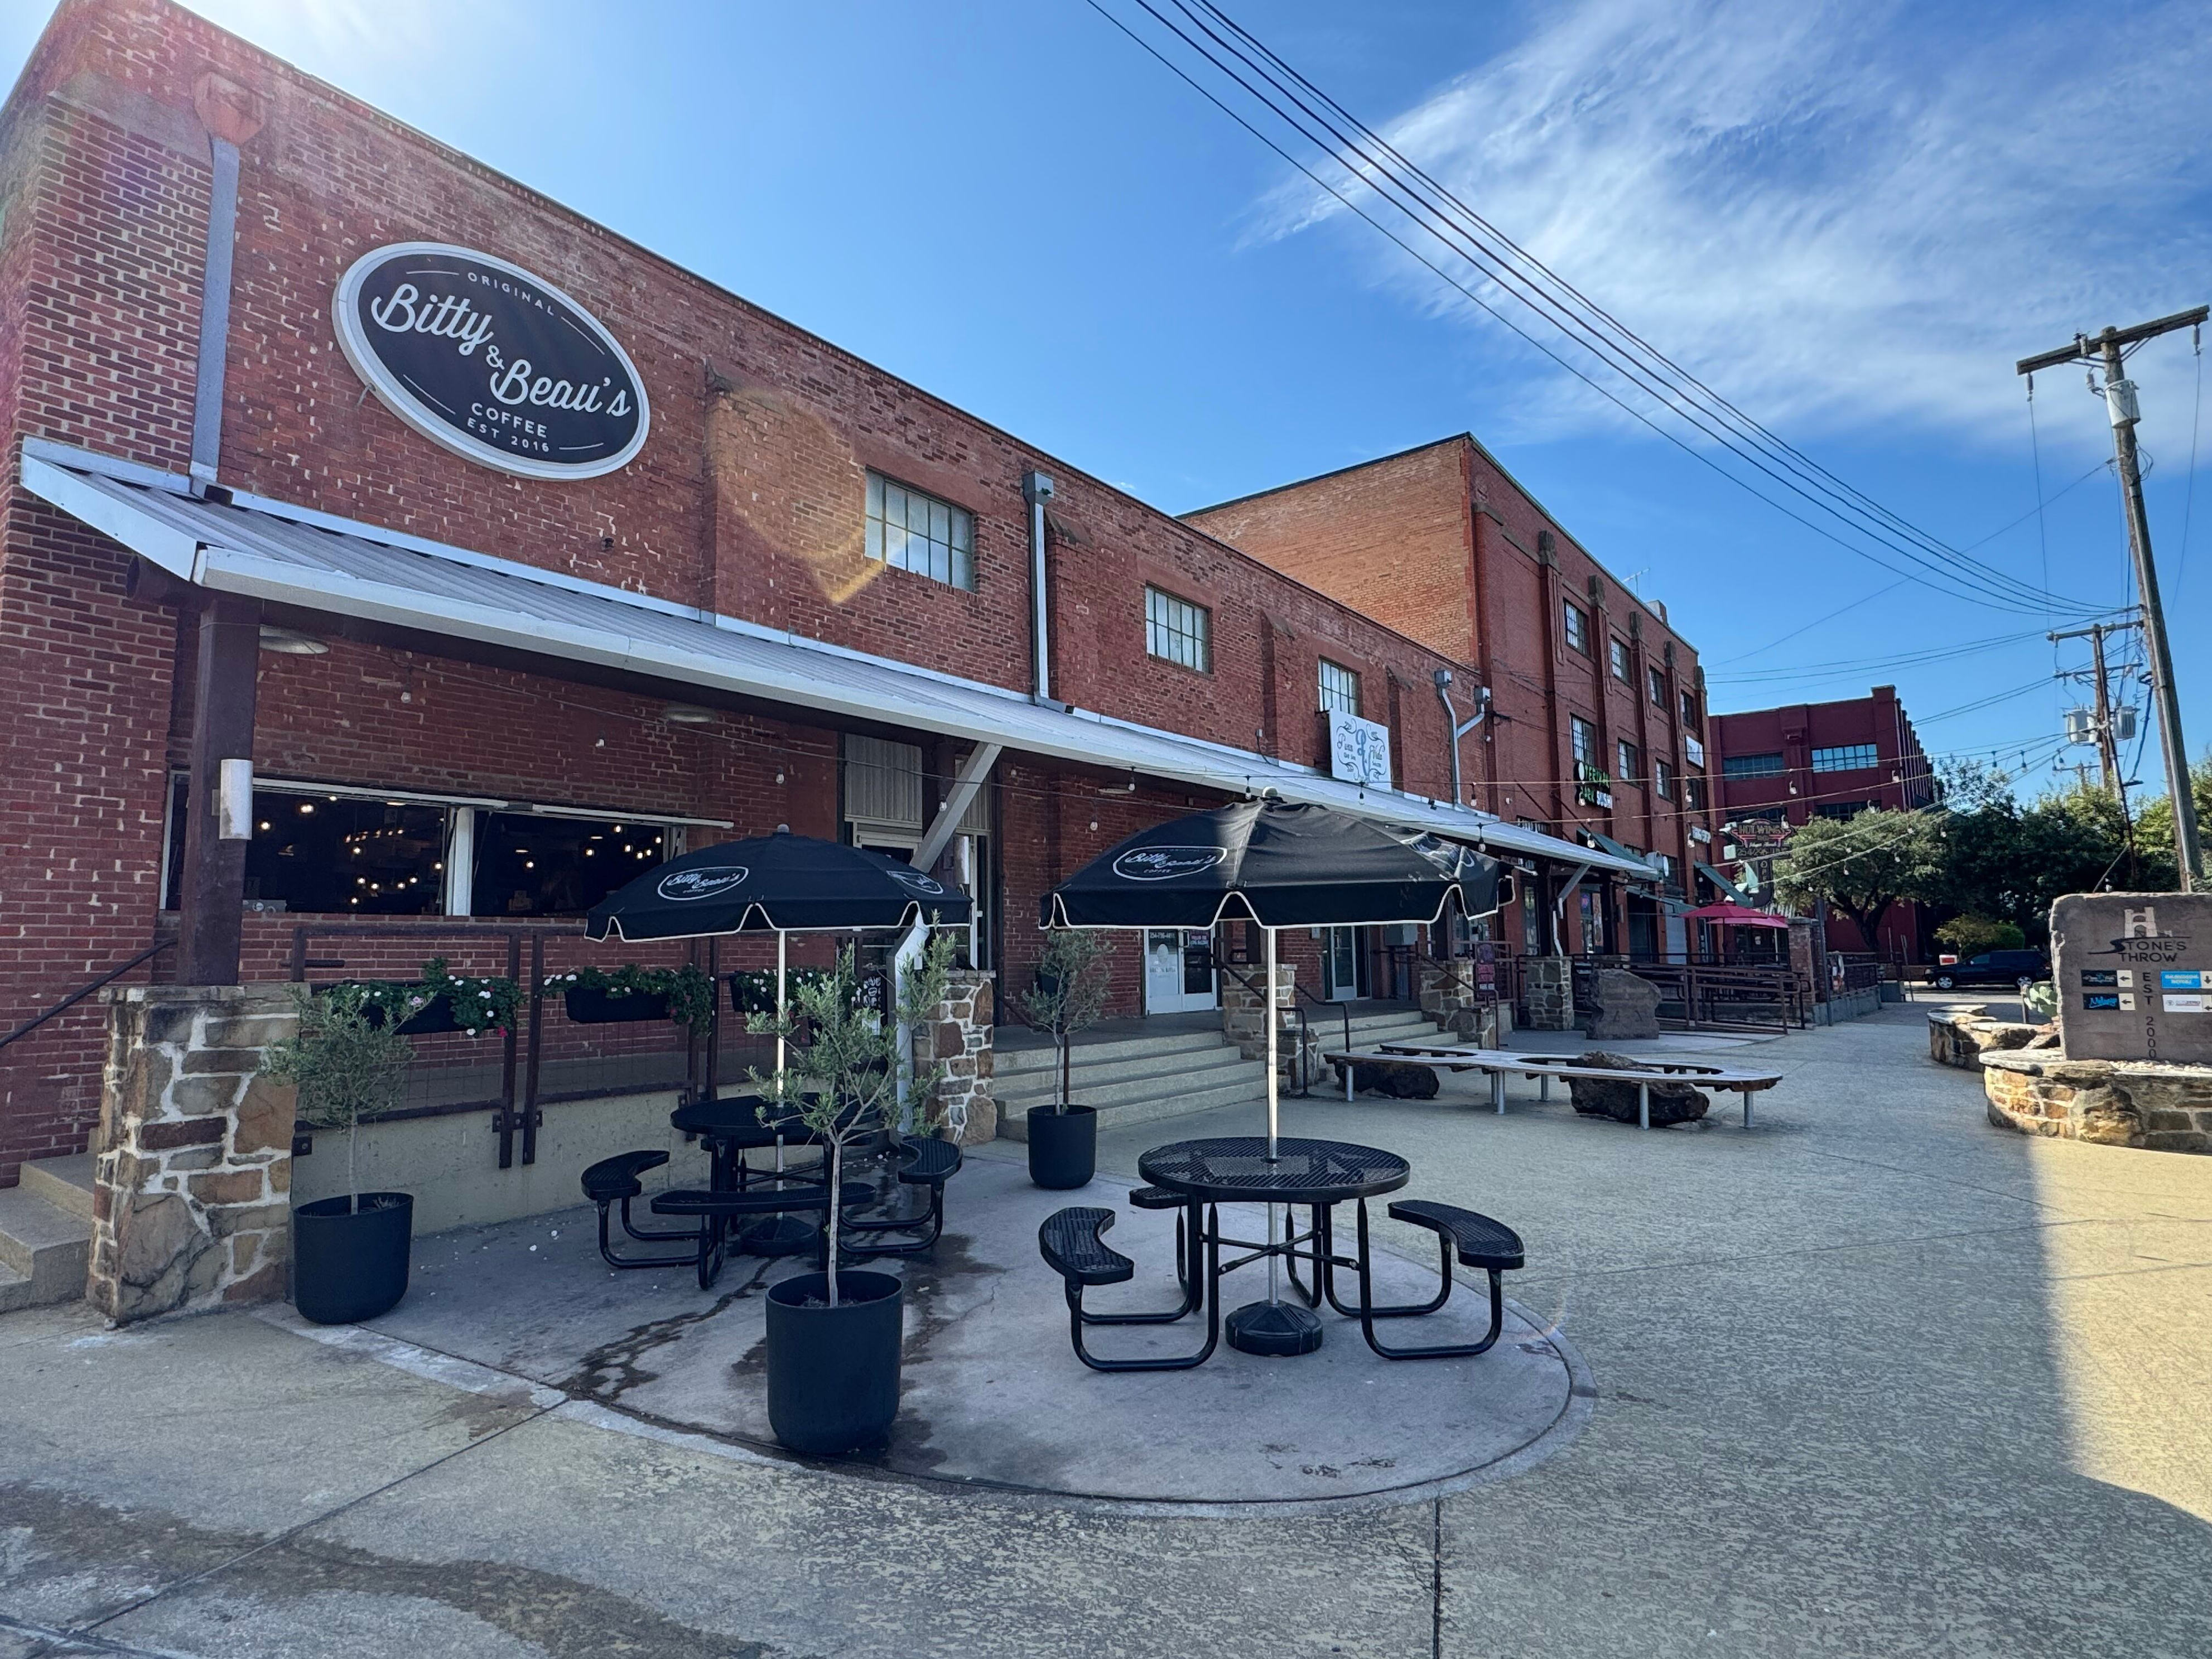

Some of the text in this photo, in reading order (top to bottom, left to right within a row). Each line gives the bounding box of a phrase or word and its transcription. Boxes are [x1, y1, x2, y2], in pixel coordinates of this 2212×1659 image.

[468, 272, 553, 316] ORIGINAL
[371, 283, 633, 417] Bitty & Beau's
[467, 418, 550, 453] EST 2016
[471, 402, 548, 438] COFFEE
[2108, 937, 2187, 954] STONE'S
[2120, 952, 2178, 963] THROW
[2142, 972, 2152, 1005] EST
[2146, 1016, 2157, 1059] 2000
